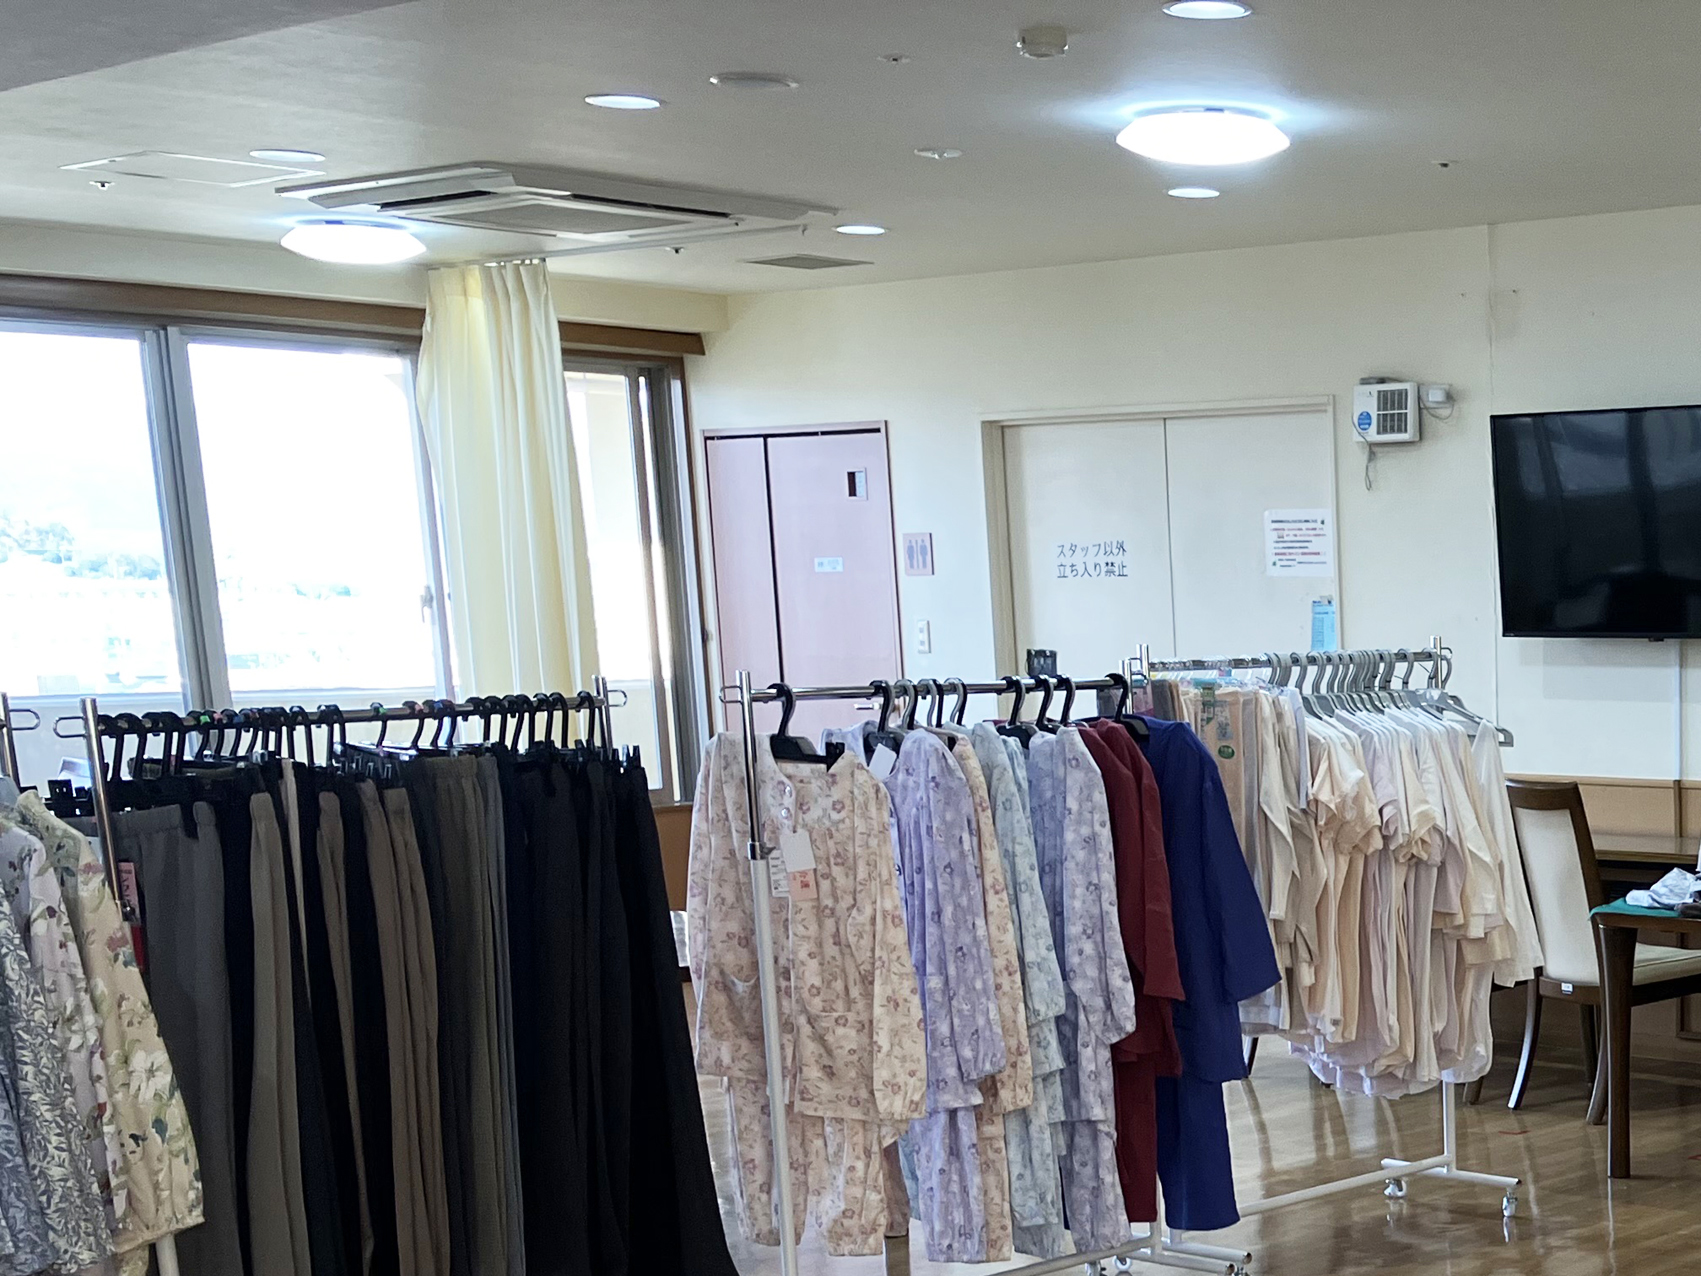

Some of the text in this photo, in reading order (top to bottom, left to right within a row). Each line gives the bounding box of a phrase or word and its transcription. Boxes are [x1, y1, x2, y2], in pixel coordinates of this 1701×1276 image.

[1057, 540, 1127, 558] スタッフ以外
[1057, 561, 1128, 579] 立ち入り禁止
